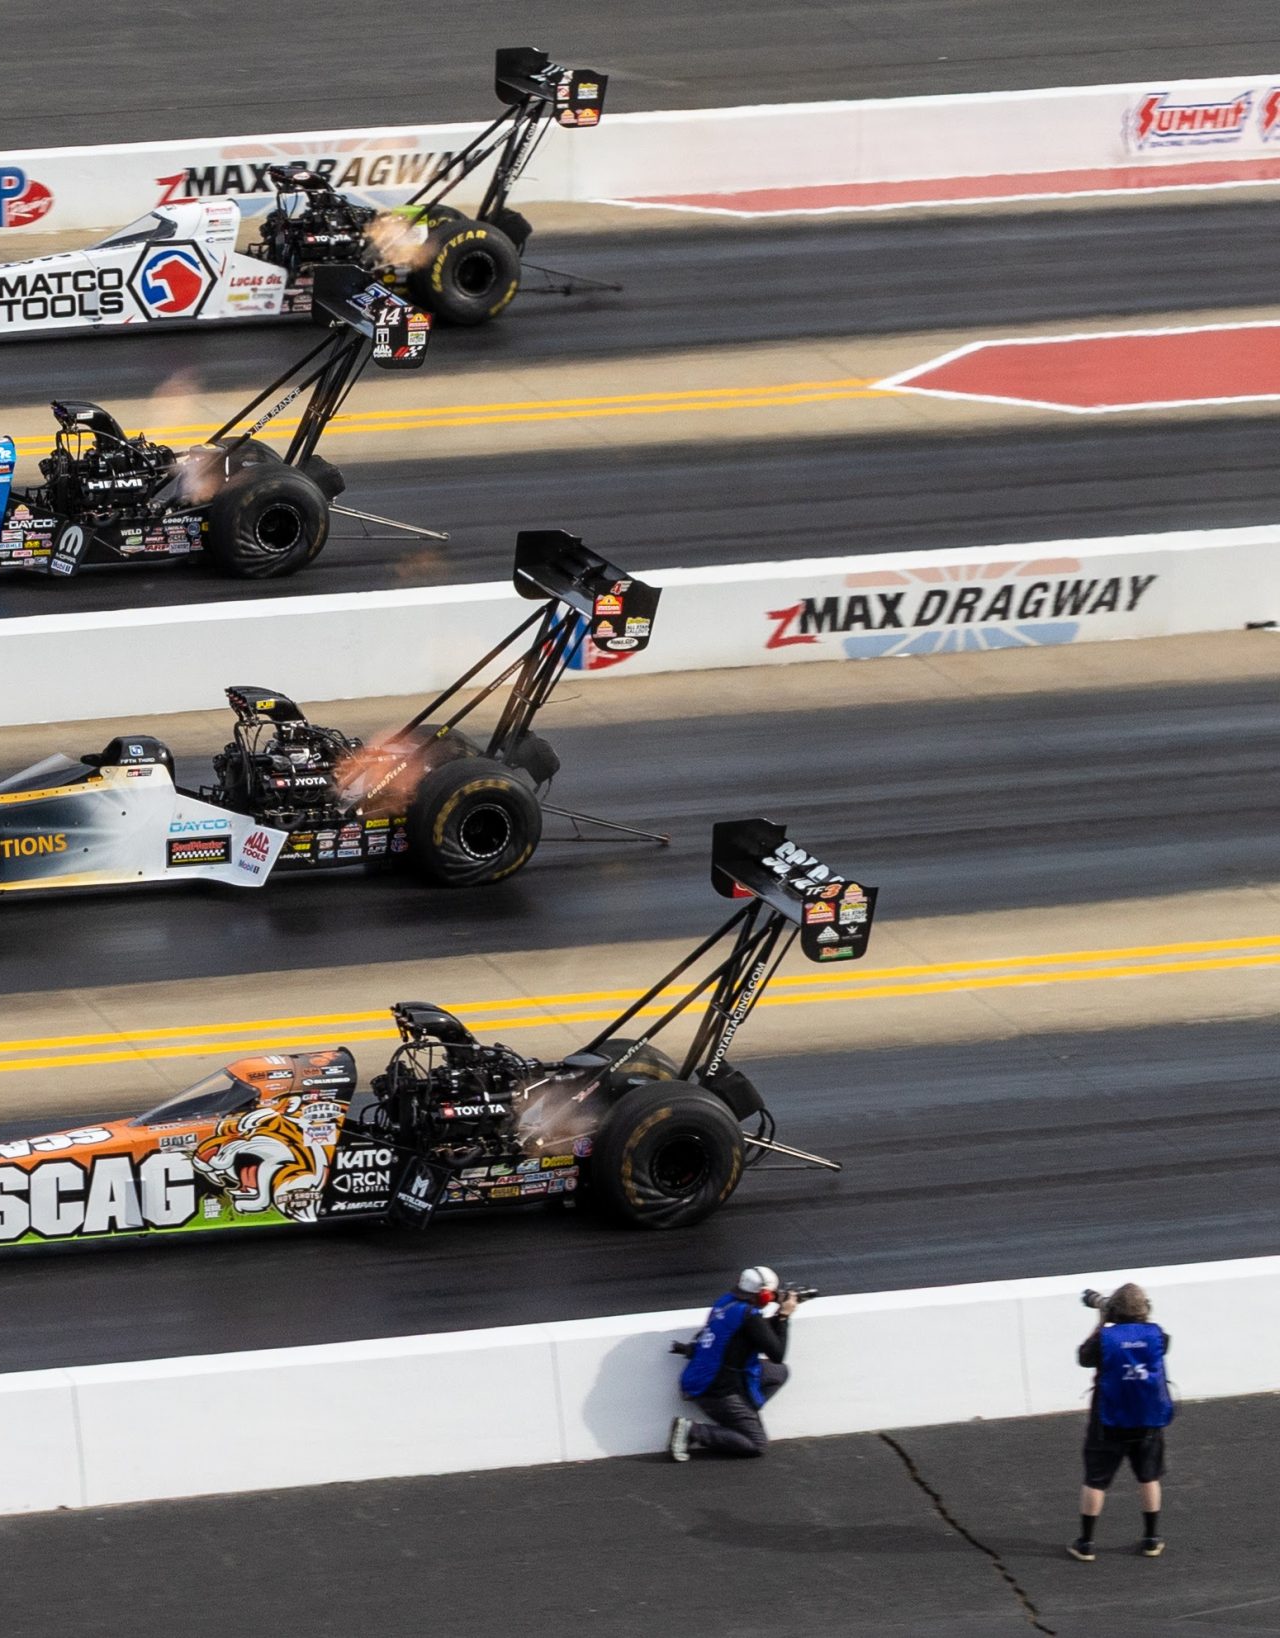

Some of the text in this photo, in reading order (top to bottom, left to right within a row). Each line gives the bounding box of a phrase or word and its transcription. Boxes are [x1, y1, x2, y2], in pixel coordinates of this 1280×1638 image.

[230, 274, 283, 287] LUCAS OIL
[375, 307, 401, 326] 14
[253, 386, 302, 434] INSURANCE
[9, 518, 53, 530] DAYCO
[120, 528, 143, 537] WELD
[907, 573, 1160, 628] DRAGWAY
[285, 776, 328, 787] TYOTA
[366, 761, 408, 800] GOODYEAR
[169, 818, 228, 833] DAYCO
[244, 831, 270, 855] MAC
[242, 846, 267, 862] TOOLS
[238, 859, 254, 872] Mobil
[705, 961, 767, 1078] TOYOTARACING.COM
[609, 1036, 649, 1073] GOODYEAR
[336, 1148, 393, 1170] KATO
[352, 1170, 390, 1187] RCN
[352, 1185, 390, 1194] CAPITAL
